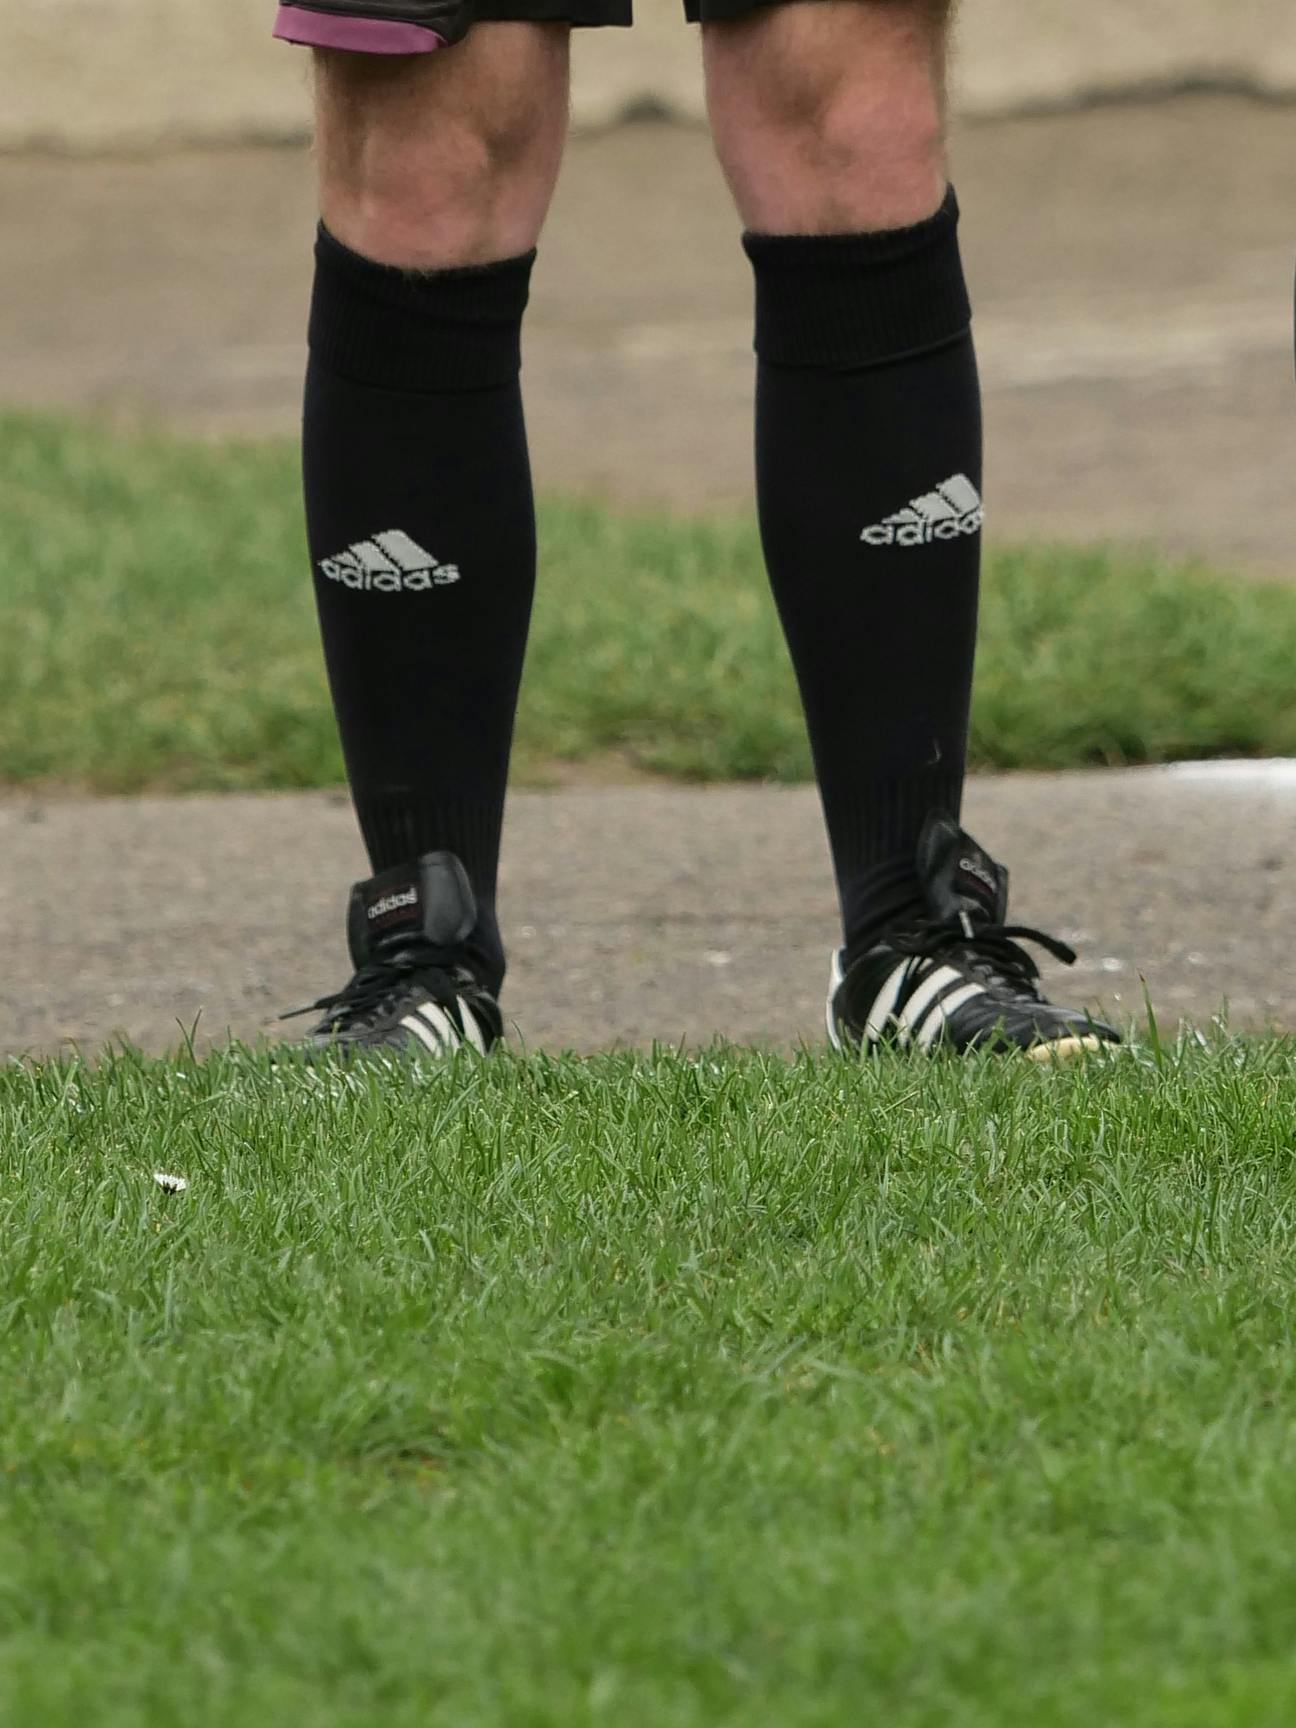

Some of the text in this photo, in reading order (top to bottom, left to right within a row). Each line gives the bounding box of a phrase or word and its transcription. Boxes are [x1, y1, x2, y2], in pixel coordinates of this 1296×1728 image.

[860, 504, 984, 546] adida
[319, 559, 461, 592] adidas
[367, 887, 418, 919] adidas
